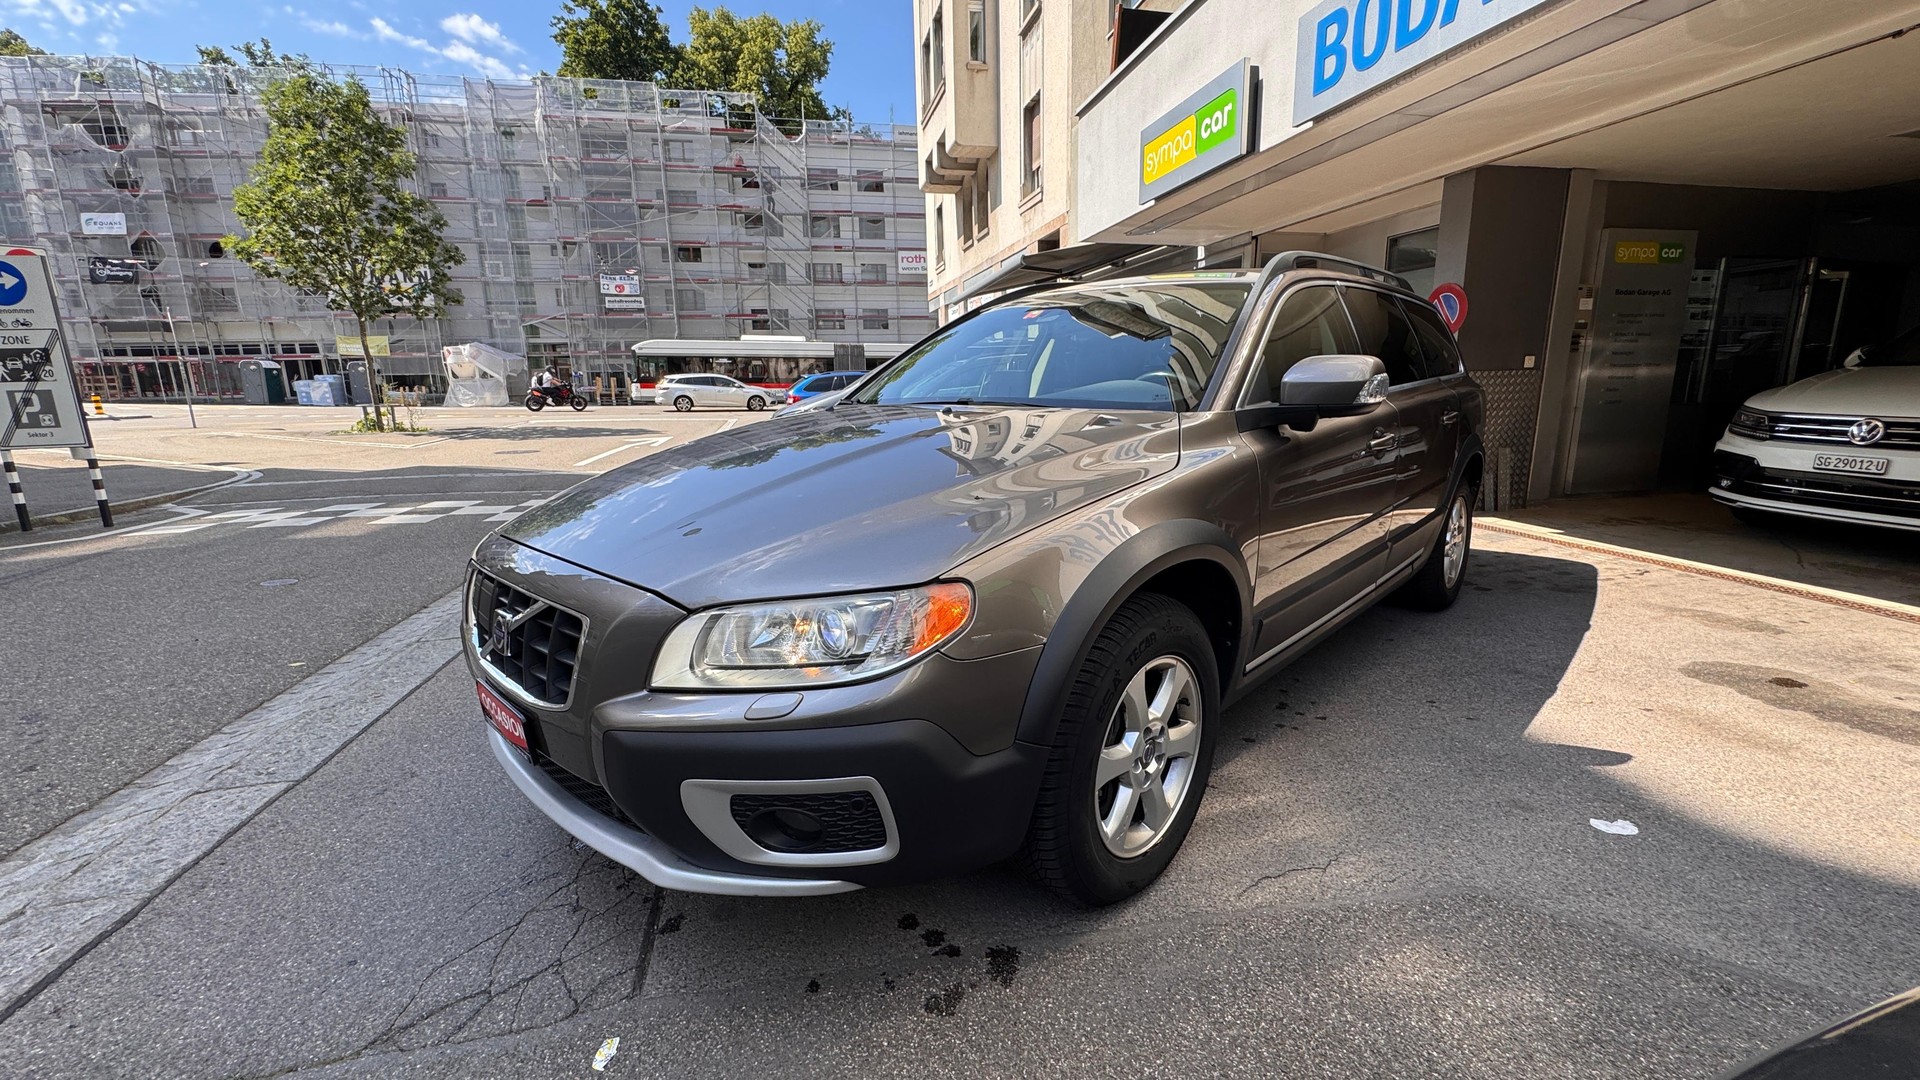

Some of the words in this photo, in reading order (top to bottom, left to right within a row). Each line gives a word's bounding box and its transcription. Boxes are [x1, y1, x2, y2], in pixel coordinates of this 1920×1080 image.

[1146, 129, 1193, 176] sympa
[1201, 102, 1233, 139] car
[1617, 247, 1656, 260] sympa
[1661, 248, 1683, 258] car
[901, 254, 926, 264] roth
[1615, 288, 1636, 296] Bodan
[1637, 289, 1660, 297] Garage
[1, 335, 31, 345] ZONE
[43, 369, 54, 378] 20
[481, 692, 526, 740] OCCASION
